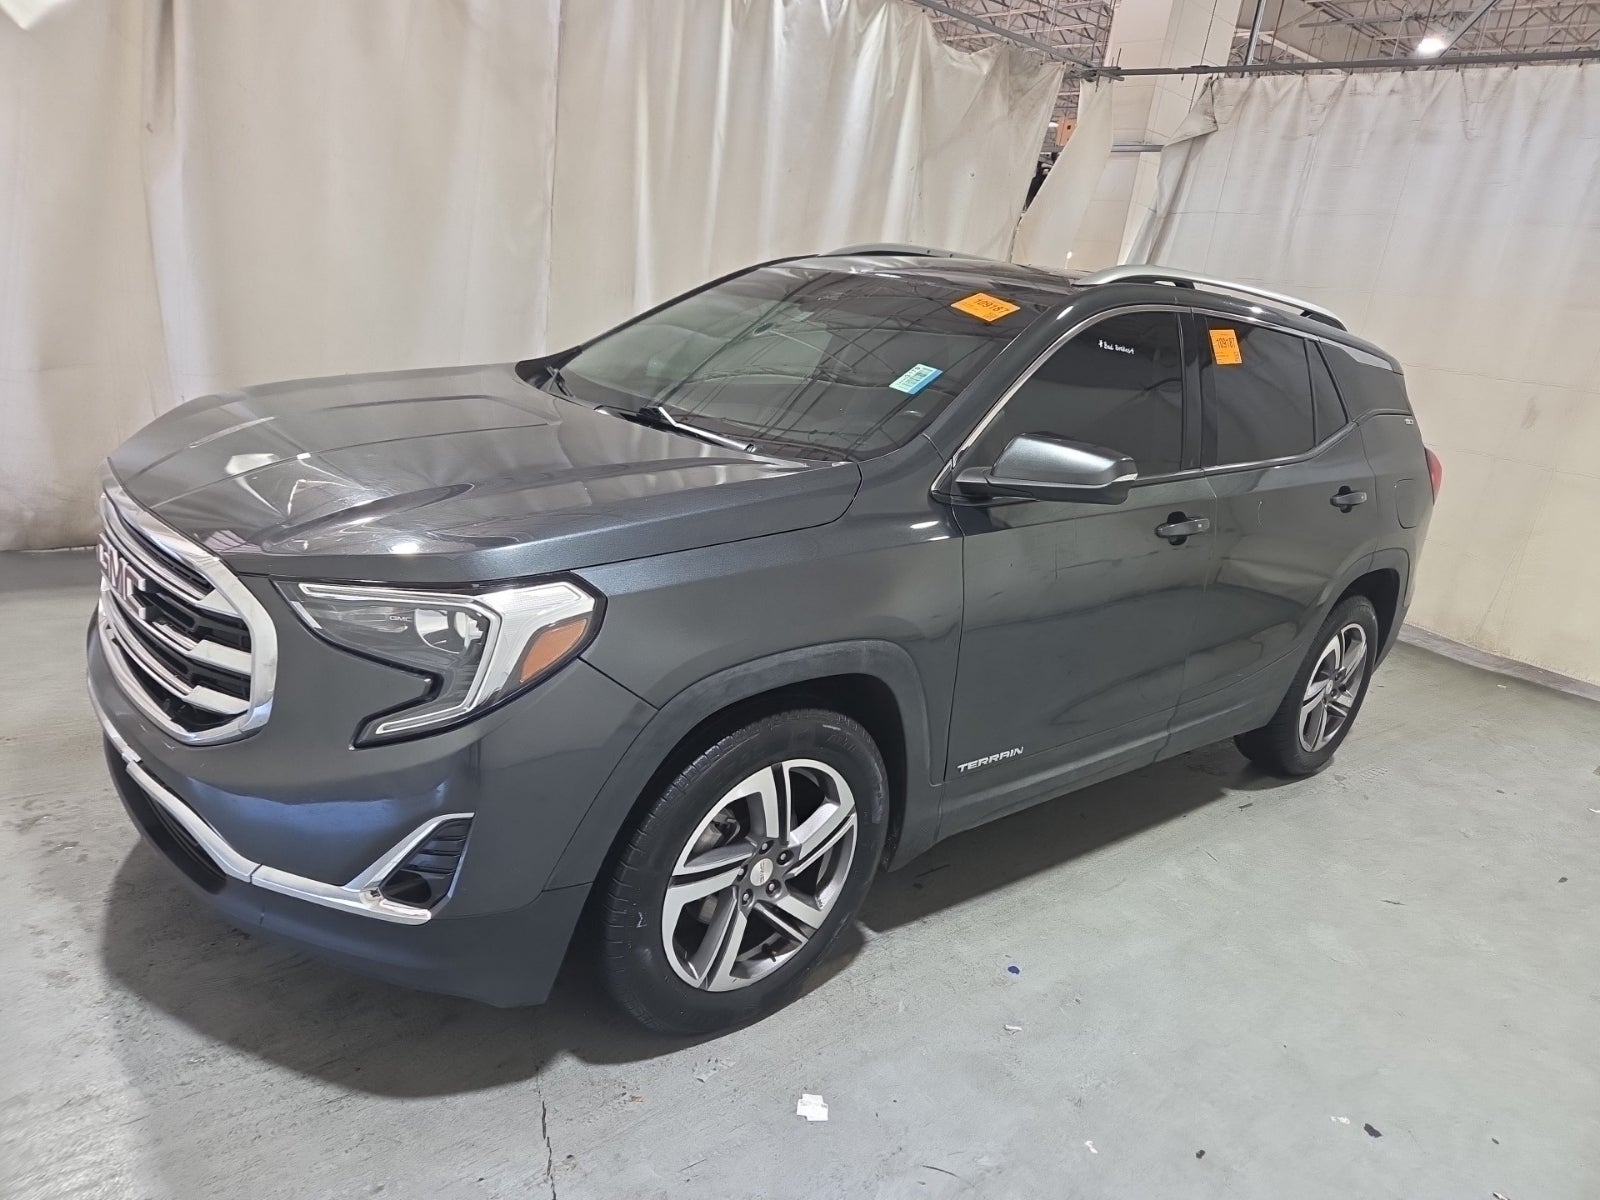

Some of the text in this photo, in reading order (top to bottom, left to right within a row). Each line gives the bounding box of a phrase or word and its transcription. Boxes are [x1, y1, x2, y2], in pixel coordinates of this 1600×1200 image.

[974, 299, 1010, 313] 109187
[1216, 337, 1236, 349] 109187
[97, 535, 146, 620] GMC
[957, 746, 1024, 773] TERRAIN
